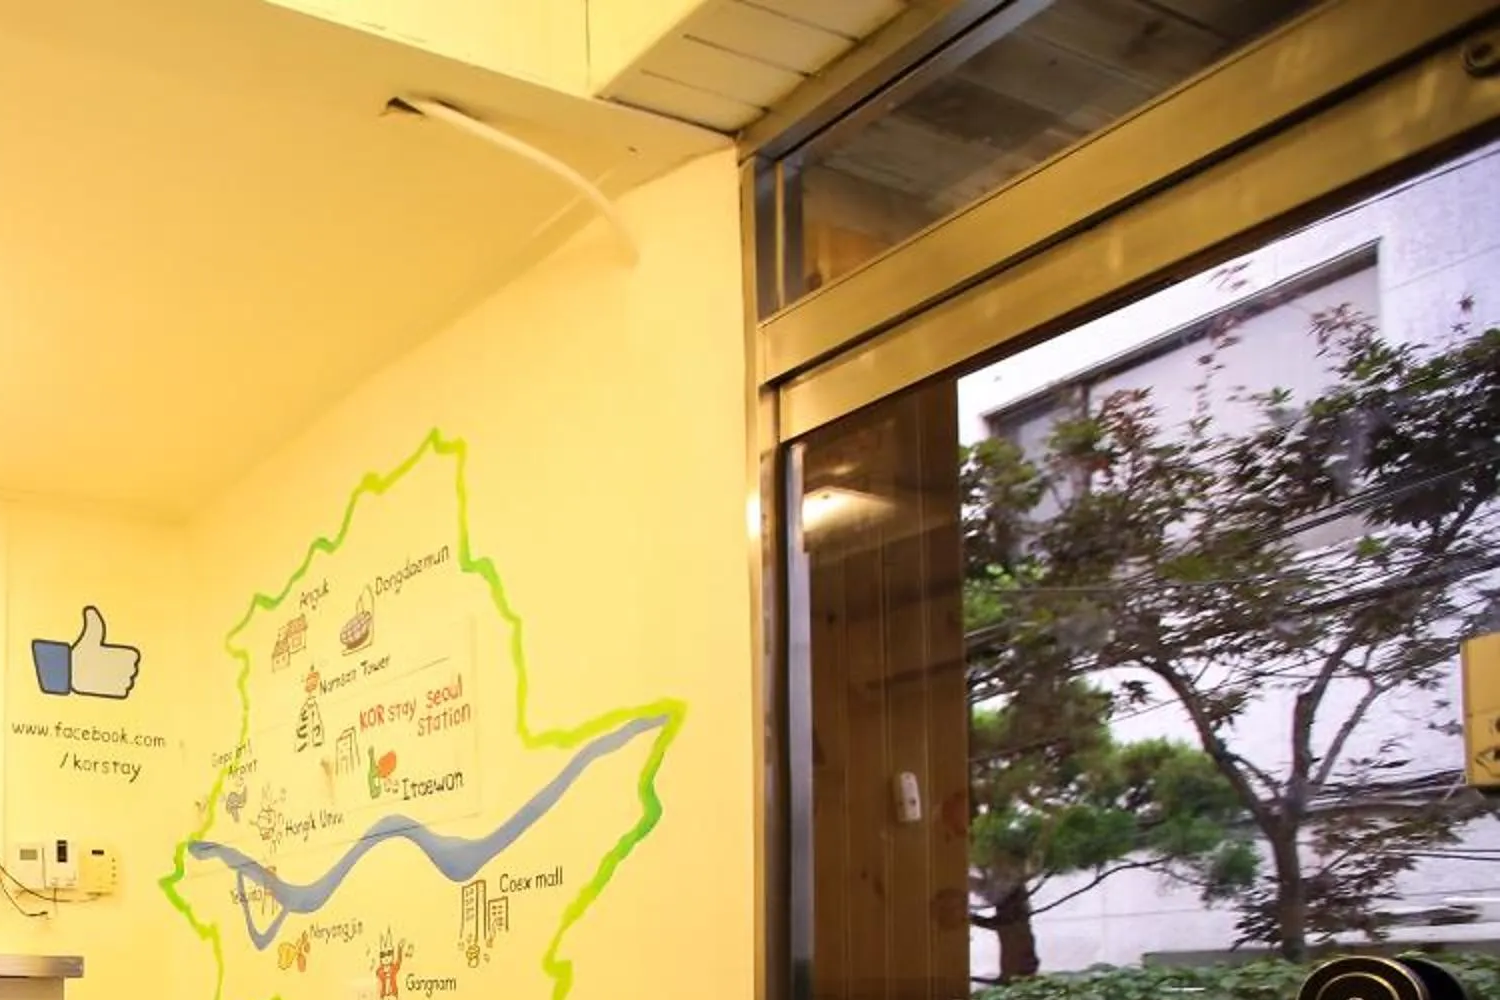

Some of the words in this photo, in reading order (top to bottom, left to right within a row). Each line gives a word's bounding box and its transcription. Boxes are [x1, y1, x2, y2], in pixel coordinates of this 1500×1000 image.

[360, 703, 386, 733] KOR
[11, 720, 167, 749] www.facebook.com
[405, 972, 458, 999] Gangnam
